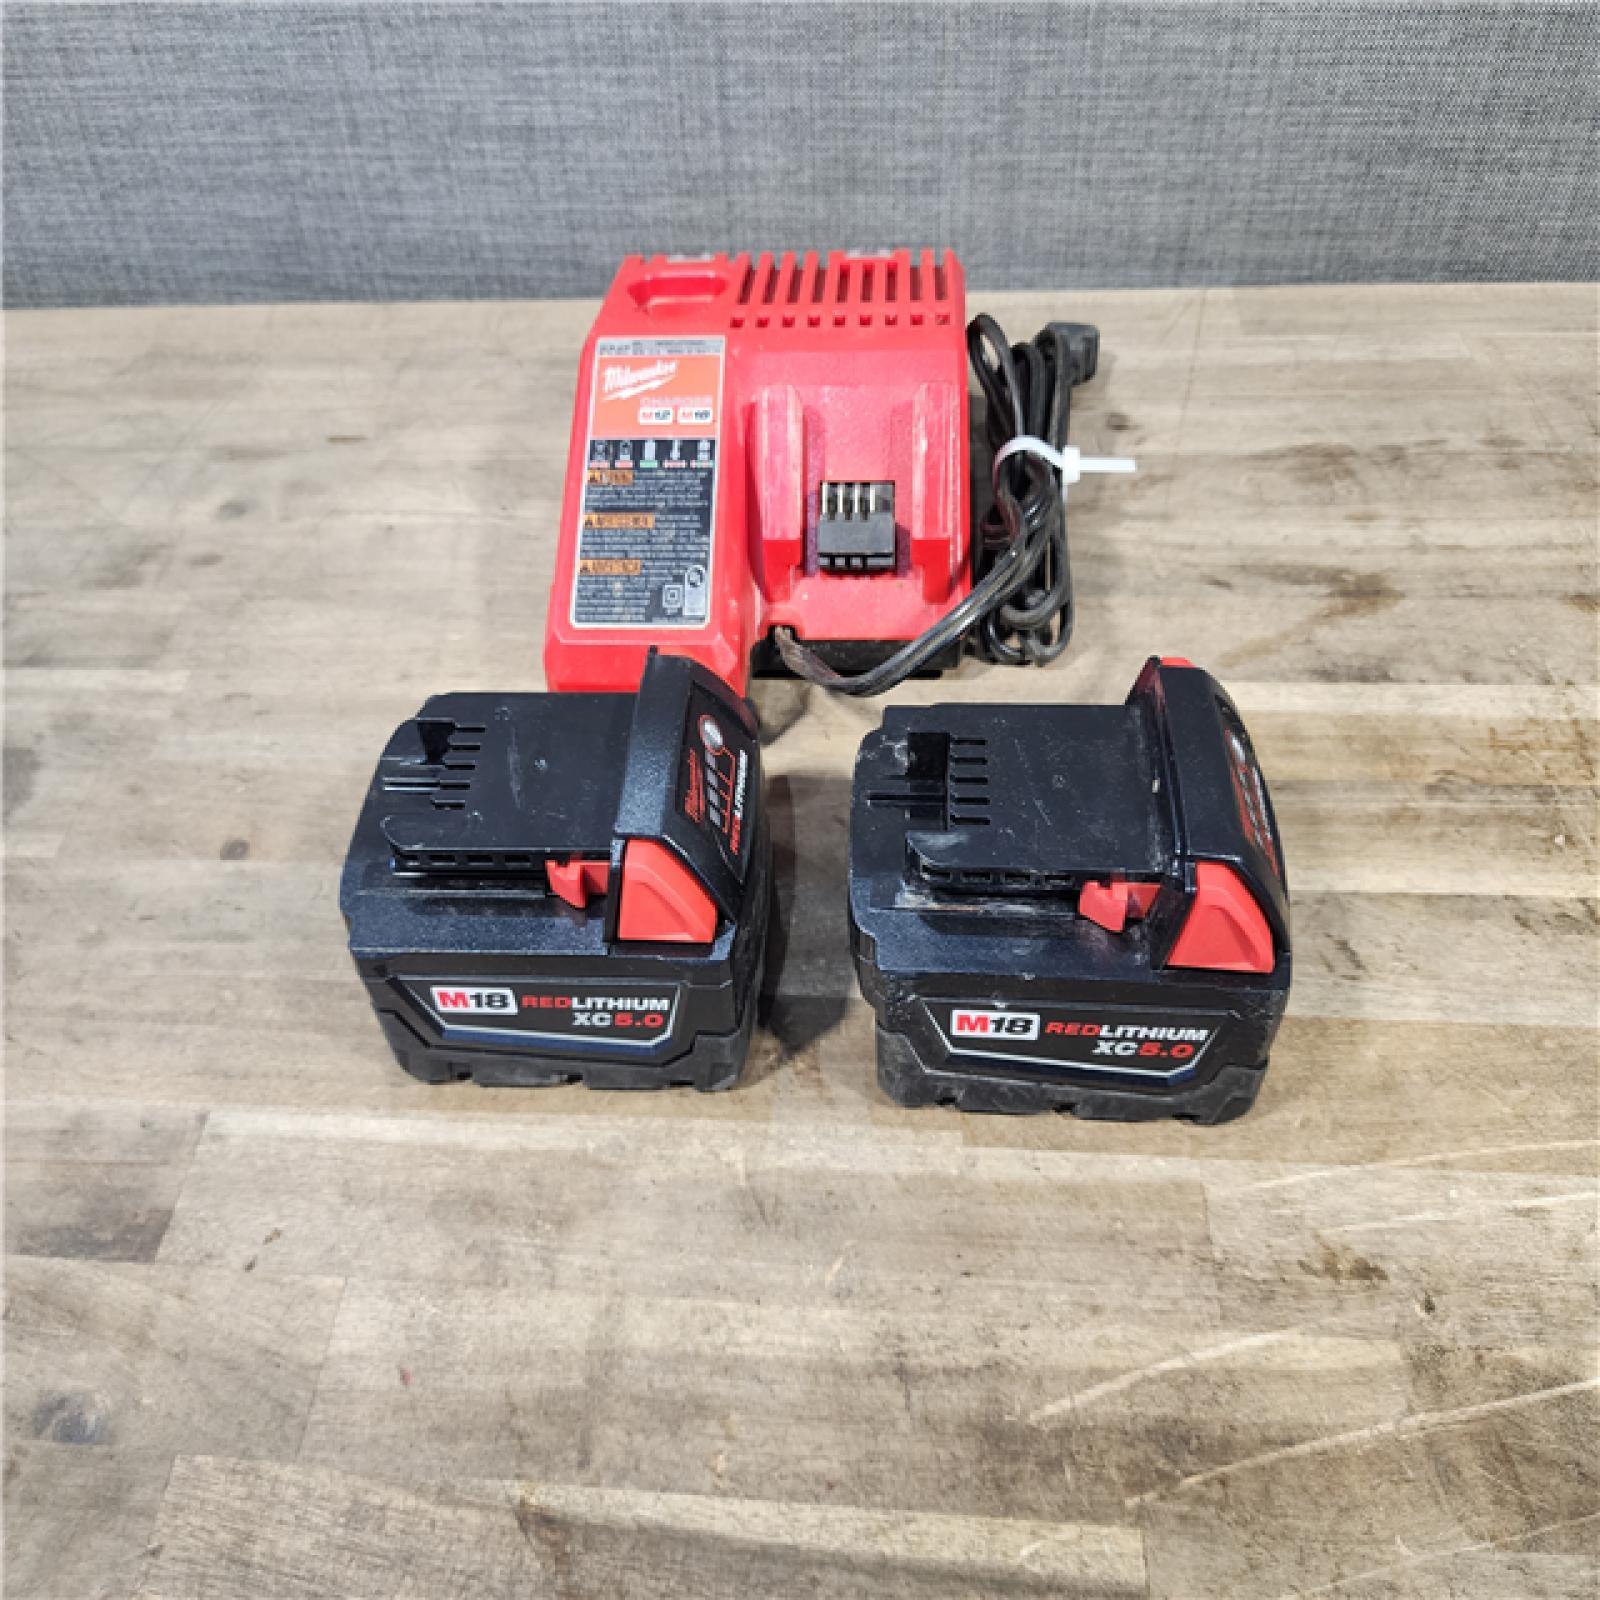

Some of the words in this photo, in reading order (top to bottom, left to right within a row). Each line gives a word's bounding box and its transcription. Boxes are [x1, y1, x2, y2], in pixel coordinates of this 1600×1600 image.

[437, 991, 511, 1009] M18
[522, 995, 670, 1011] REDLITHIUM
[957, 1014, 1033, 1034] M18
[1045, 1021, 1209, 1041] REDLITHIUM
